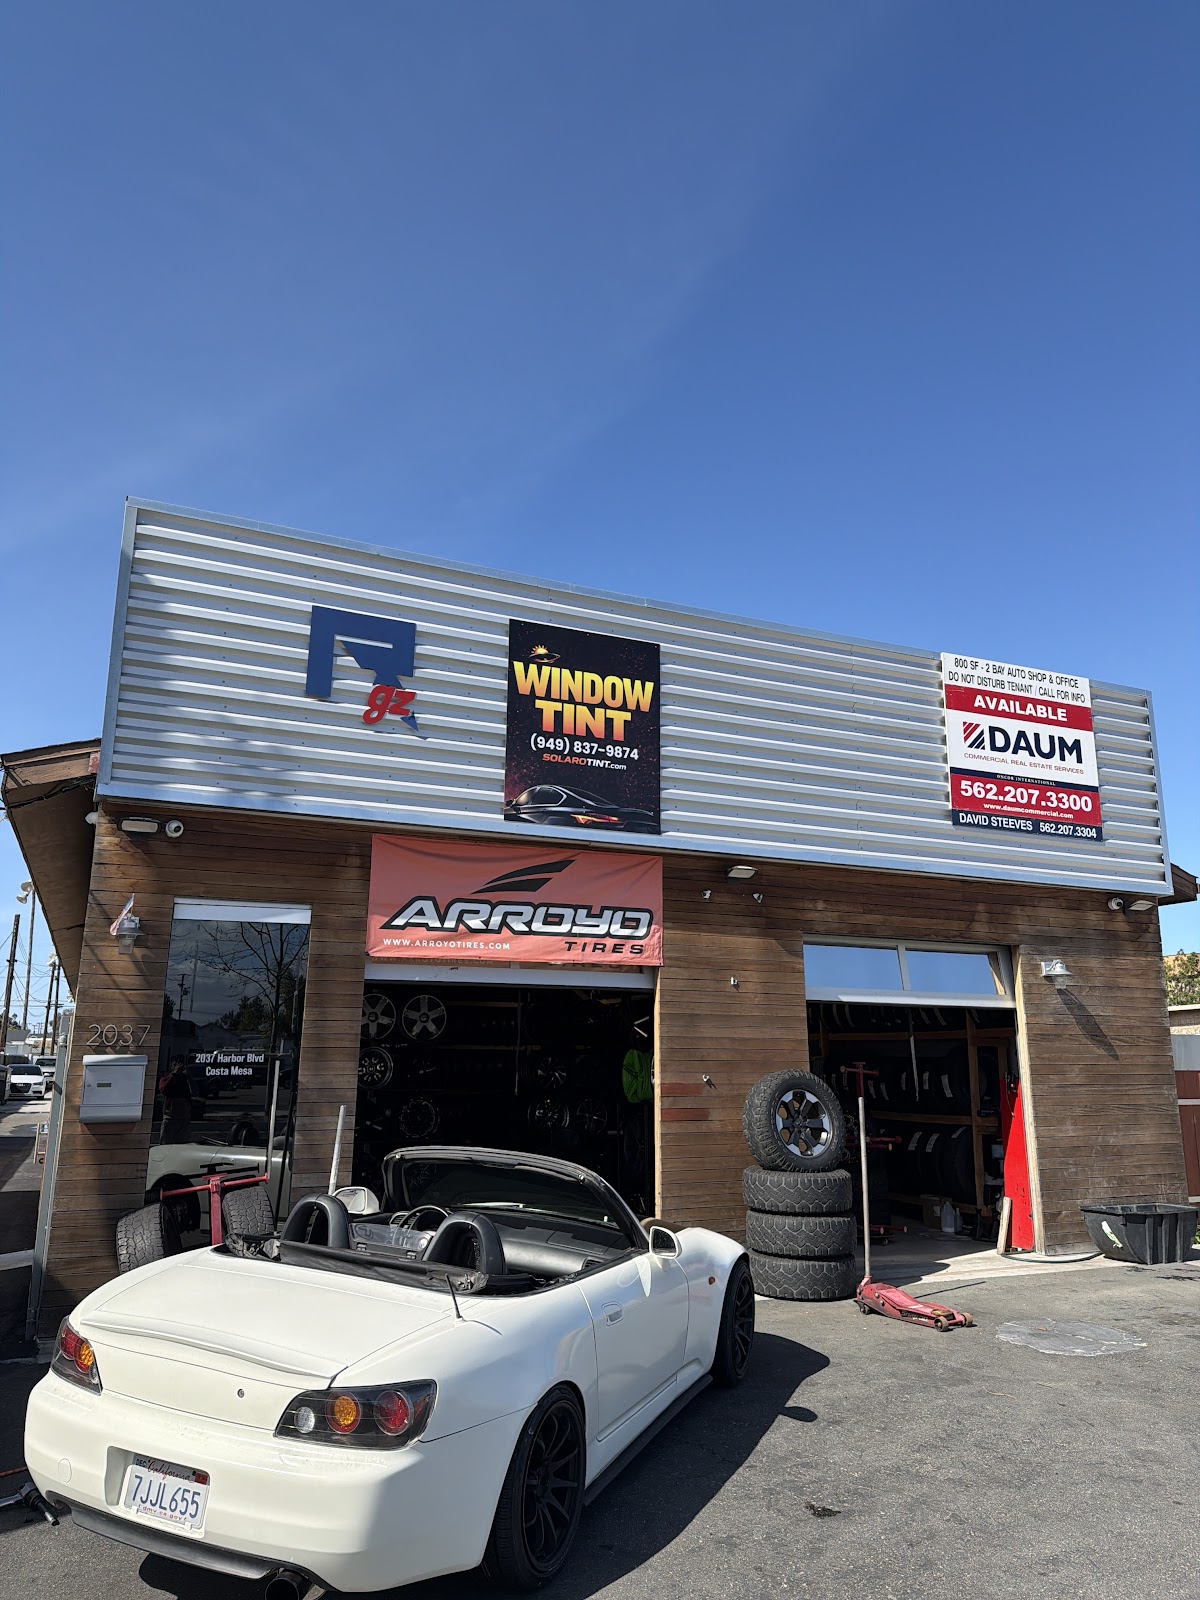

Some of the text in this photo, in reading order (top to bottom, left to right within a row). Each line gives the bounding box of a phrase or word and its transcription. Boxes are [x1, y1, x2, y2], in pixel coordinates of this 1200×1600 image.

[513, 660, 655, 713] WINDOW
[954, 657, 969, 669] 800
[970, 660, 979, 671] SF
[985, 663, 990, 673] 2
[992, 664, 1006, 676] BAY
[1007, 667, 1027, 680] AUTO
[1027, 670, 1047, 684] SHOP
[1048, 674, 1055, 685] &
[1055, 675, 1079, 689] OFFICE
[948, 671, 960, 682] DO
[961, 675, 975, 685] NOT
[977, 677, 1006, 690] DISTURB
[1007, 681, 1033, 695] TENANT
[1038, 686, 1055, 699] CALL
[1056, 690, 1069, 702] FOR
[1070, 692, 1086, 704] INFO
[534, 699, 632, 742] TINT
[973, 695, 1068, 722] AVAILABLE
[530, 732, 639, 761] (949) 837-9874
[988, 725, 1083, 764] DAUM
[964, 752, 1084, 775] COMMERCIAL REAL ESTATE SERVICES
[960, 779, 1093, 813] 562.207.3300
[983, 802, 1074, 820] www.daumcommercial.com
[959, 812, 1097, 839] DAVID STEEVES 562.207.3304
[379, 895, 654, 940] ARROYO
[383, 938, 510, 950] WWW.ARROYOTIRES.COM
[565, 941, 644, 954] TIRES
[86, 1024, 151, 1047] 2037
[195, 1052, 265, 1064] 2037 Harbor Blvd
[205, 1066, 252, 1076] Costa Mesa
[147, 1460, 194, 1483] California
[132, 1474, 201, 1519] 7JJL655
[142, 1505, 183, 1521] dmv.ca.gov
